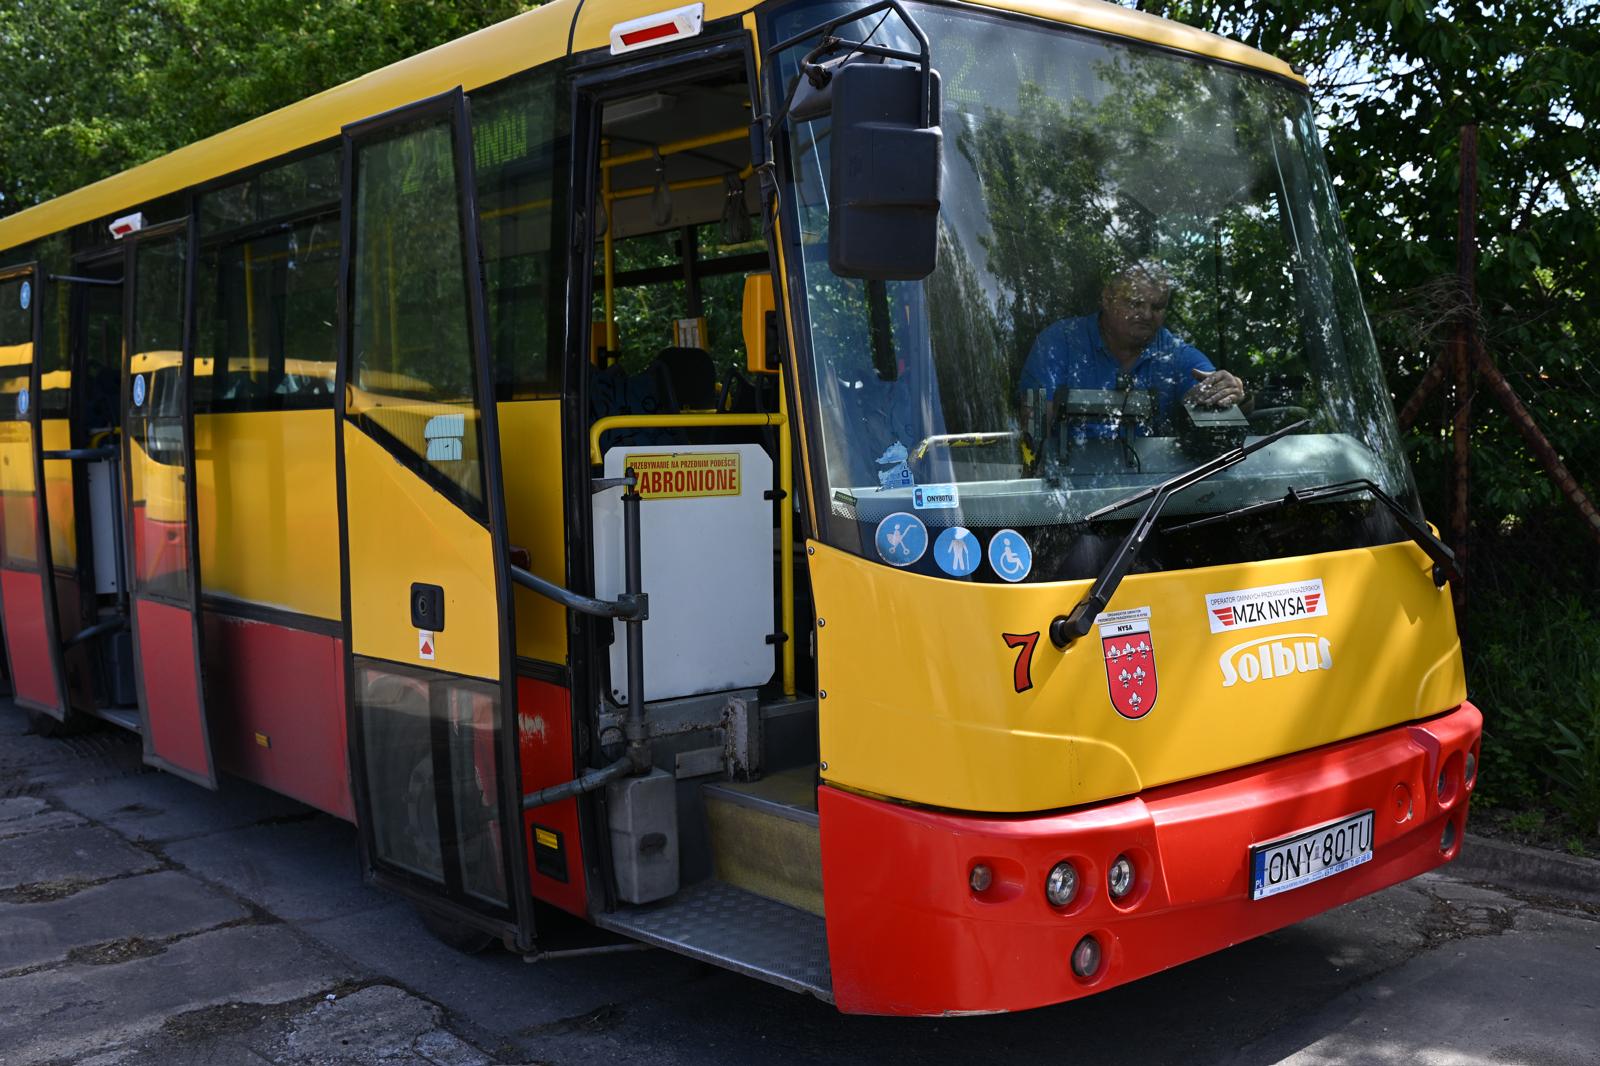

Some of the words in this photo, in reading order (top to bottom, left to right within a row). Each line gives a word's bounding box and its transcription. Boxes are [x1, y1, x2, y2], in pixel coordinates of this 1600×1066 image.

[941, 36, 981, 102] 2
[630, 461, 669, 471] PRZEBYWANIE
[671, 460, 680, 469] NA
[681, 459, 709, 469] PRZEDNIM
[710, 457, 737, 468] PODEŚCIE
[926, 494, 953, 503] ONY80TU
[1210, 596, 1236, 606] OPERATOR
[1236, 593, 1261, 603] GMINNYCH
[1232, 601, 1267, 625] MZK
[1268, 596, 1306, 619] NYSA
[1117, 624, 1133, 632] NYSA
[1001, 630, 1040, 693] 7
[1219, 632, 1332, 687] Solbus
[1268, 839, 1316, 884] ONY
[1322, 818, 1371, 866] 80TU
[1255, 878, 1264, 890] PL
